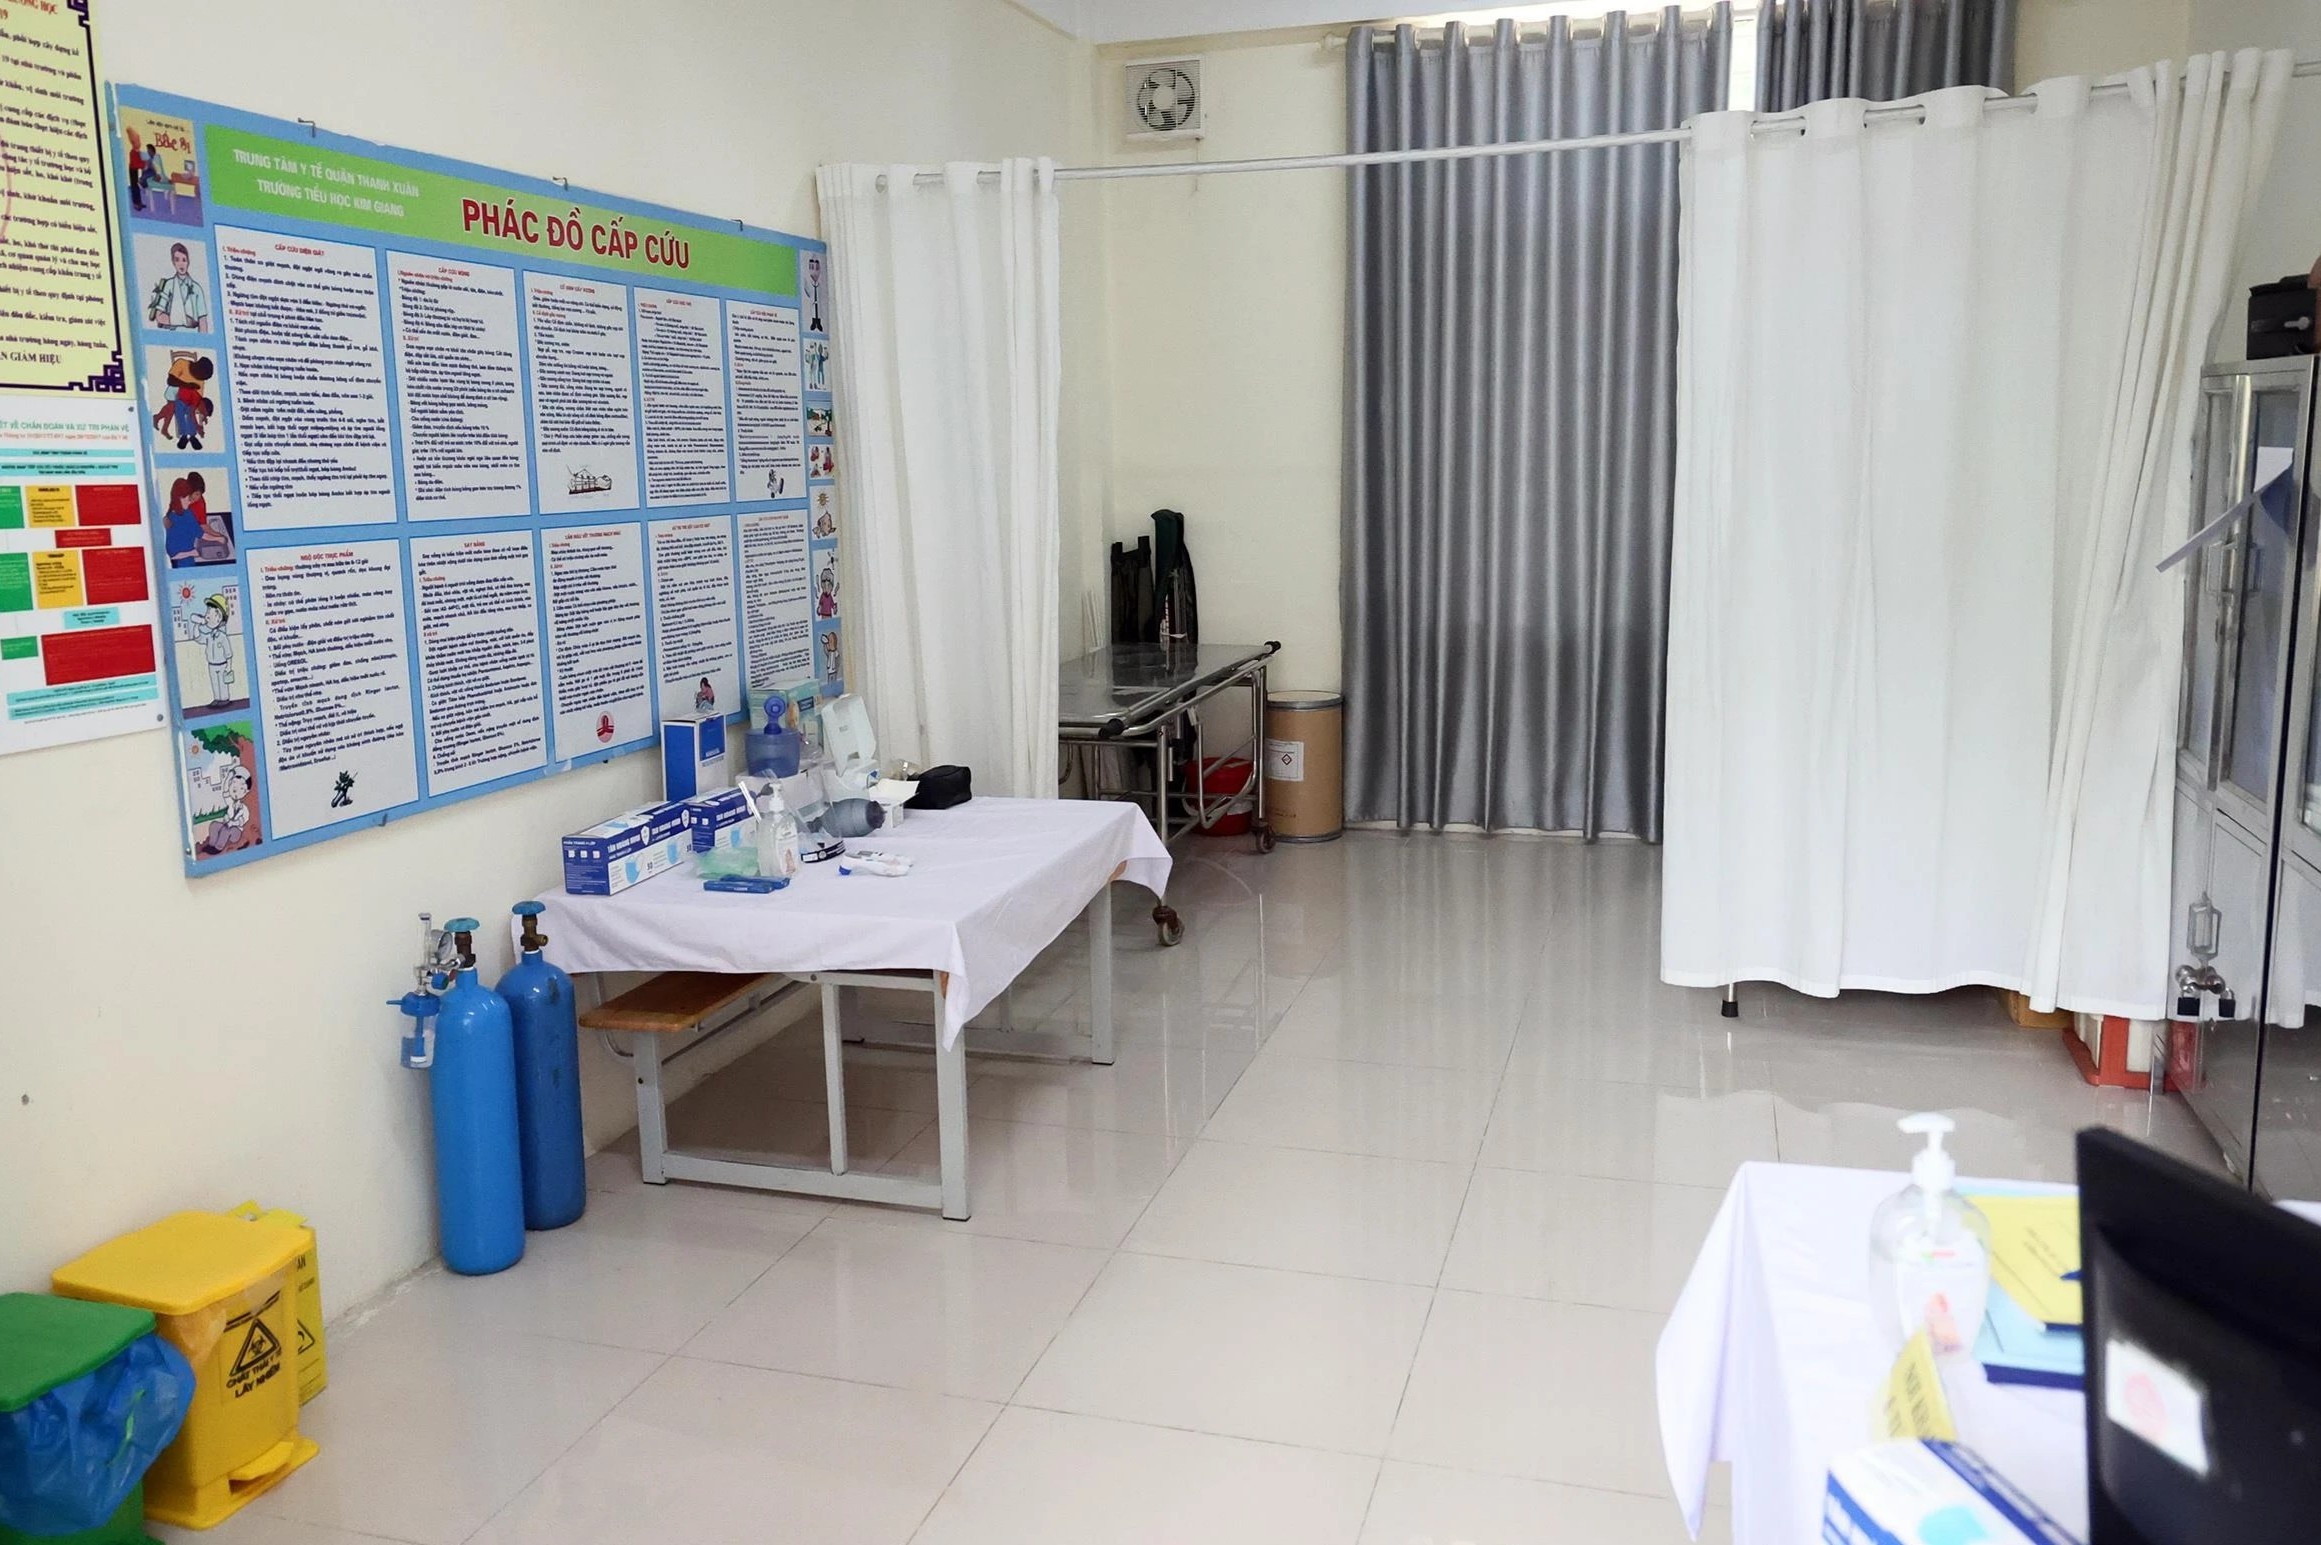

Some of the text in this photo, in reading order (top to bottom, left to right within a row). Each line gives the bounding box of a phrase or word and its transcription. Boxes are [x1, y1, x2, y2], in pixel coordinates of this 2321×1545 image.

[233, 149, 420, 198] TRUNG TÂM Y TẾ QUẬN THANH XUÂN
[257, 178, 404, 217] TRƯỜNG TIỂU HỌC KIM GIANG
[462, 198, 690, 269] PHÁC ĐỒ CẤP CỨU
[10, 351, 37, 362] GIÁM
[39, 353, 62, 365] HIỆU
[226, 1370, 249, 1389] CHẤT
[235, 1380, 254, 1398] LÂY
